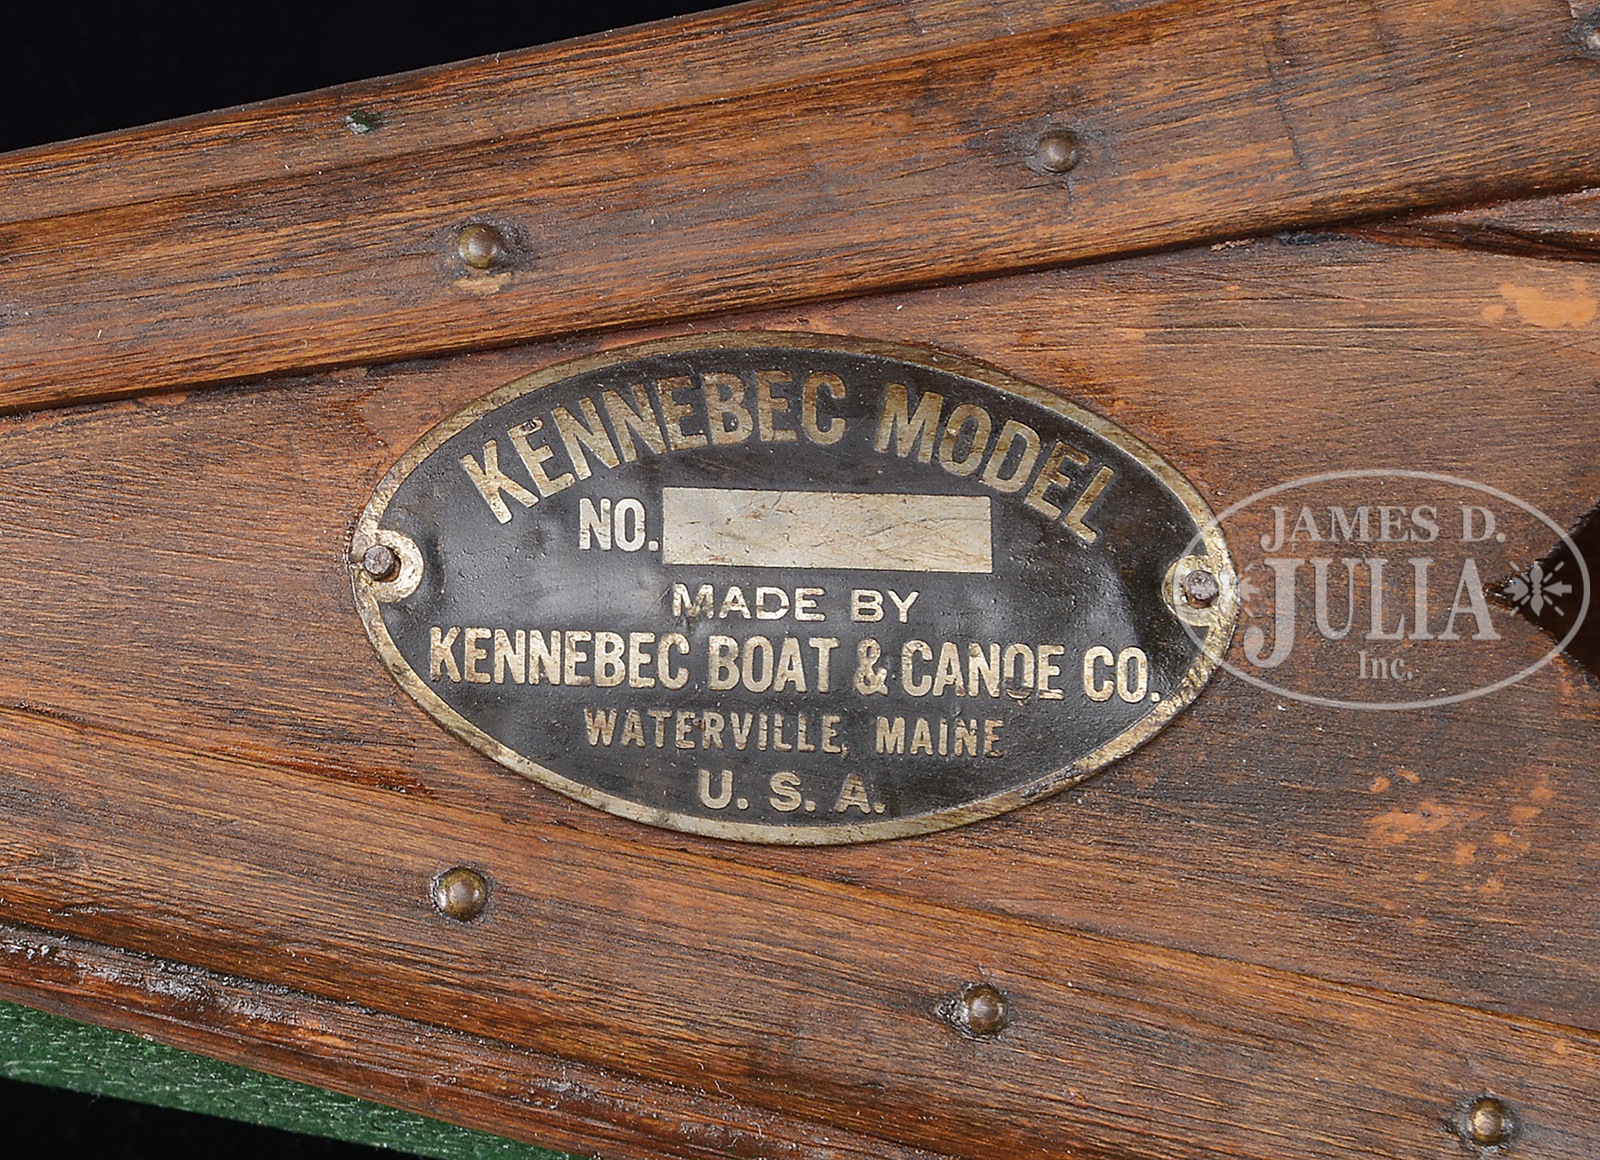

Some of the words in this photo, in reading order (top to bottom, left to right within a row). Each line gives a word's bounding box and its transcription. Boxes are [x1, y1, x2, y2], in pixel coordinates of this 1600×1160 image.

[460, 370, 847, 525] KENNEBEC
[874, 383, 1117, 544] MODEL
[578, 497, 660, 552] NO.
[672, 583, 826, 622] MADE
[851, 589, 920, 624] BY
[429, 626, 690, 689] KENNEBEC
[708, 634, 840, 694] BOAT
[854, 637, 888, 696] &
[901, 639, 1065, 701] CANOE
[1083, 646, 1161, 704] CO.
[876, 715, 1005, 758] MAINE
[699, 769, 749, 811] U.
[770, 771, 817, 813] S.
[838, 773, 886, 815] A.
